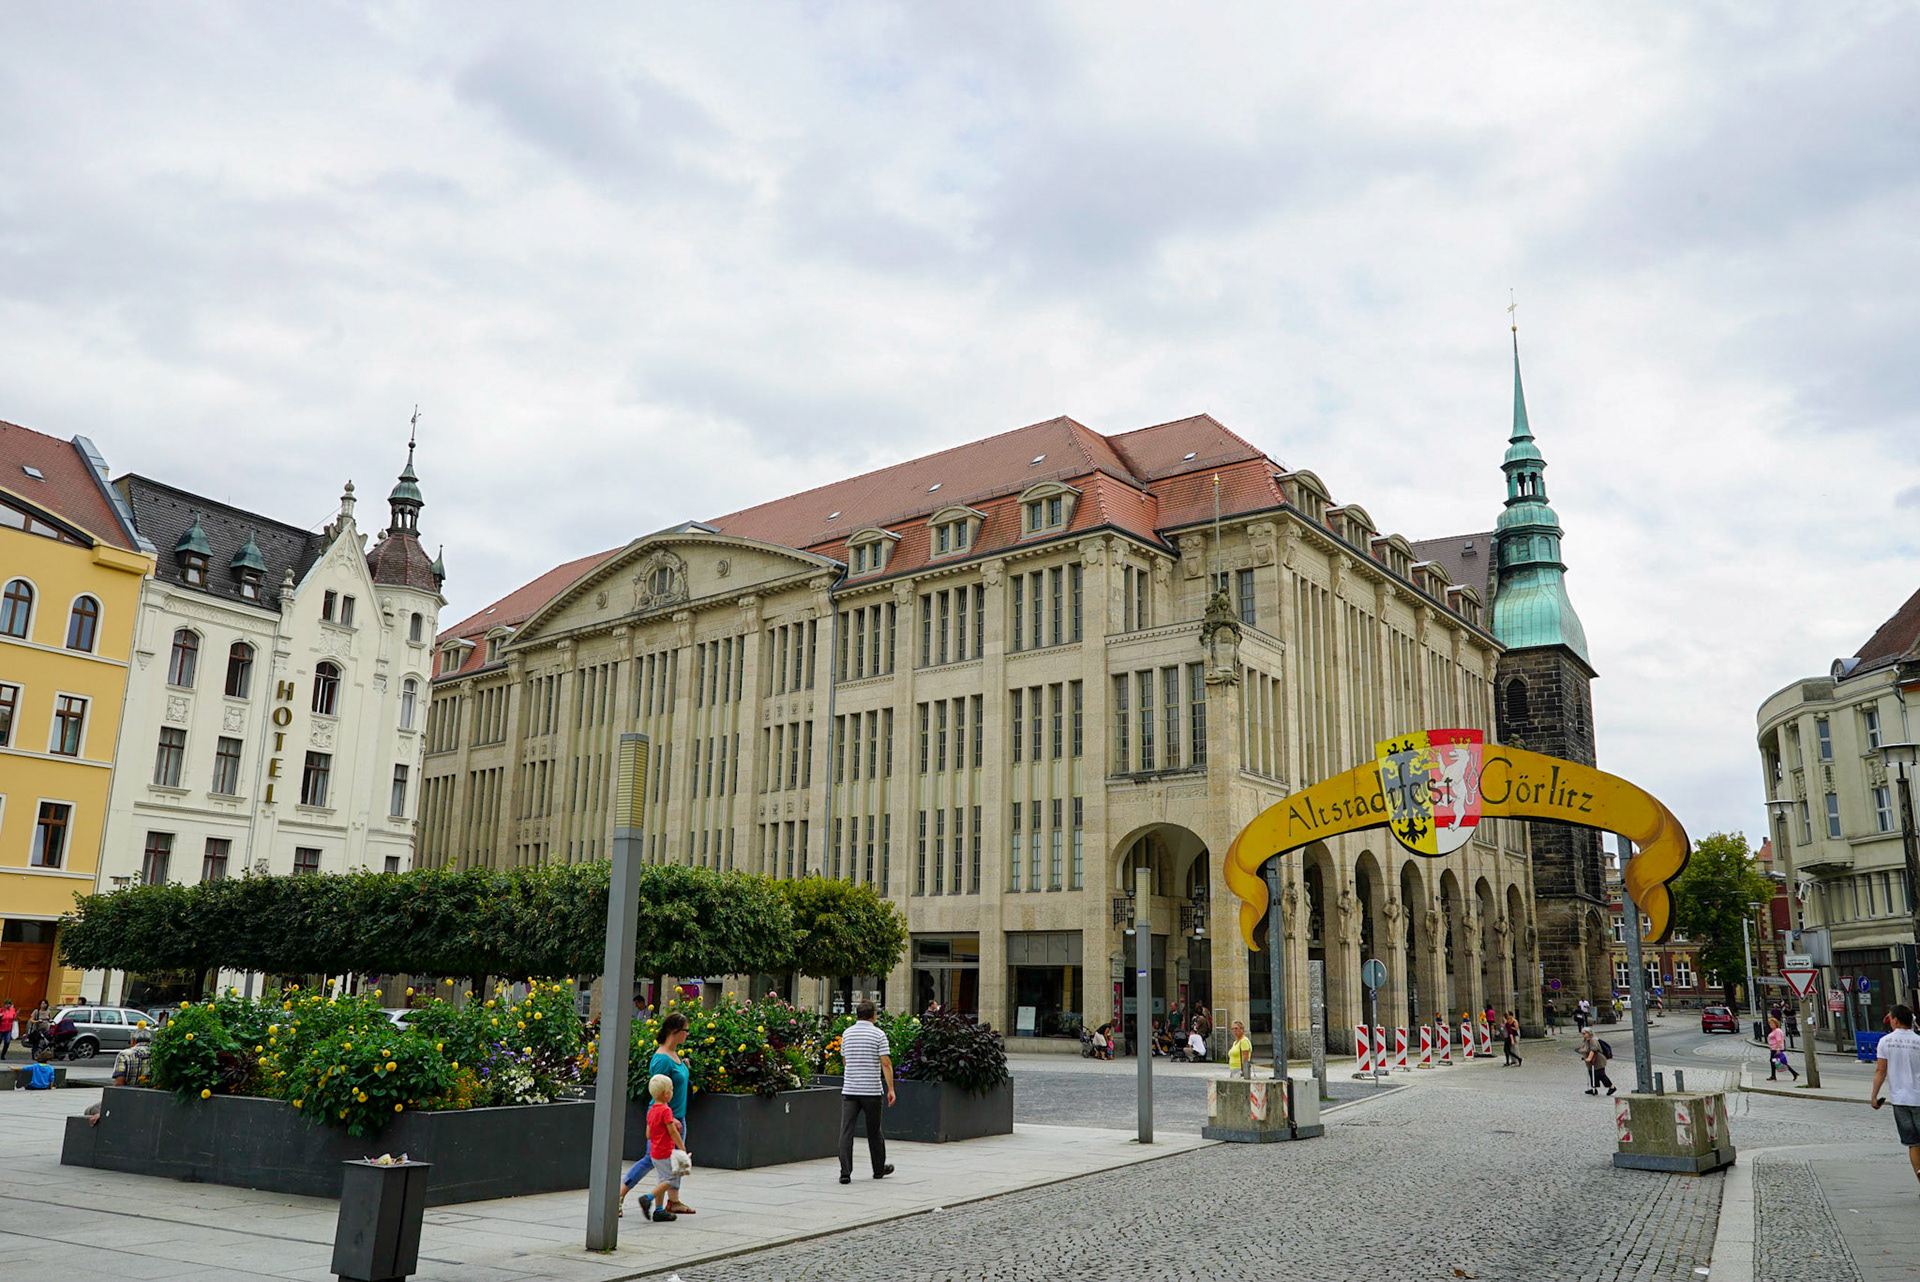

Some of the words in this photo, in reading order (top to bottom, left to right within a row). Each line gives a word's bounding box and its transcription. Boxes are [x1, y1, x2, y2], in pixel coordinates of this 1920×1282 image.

[265, 680, 294, 804] HOTEL
[1288, 762, 1454, 837] Altstadtfest
[1479, 757, 1594, 812] Görlitz
